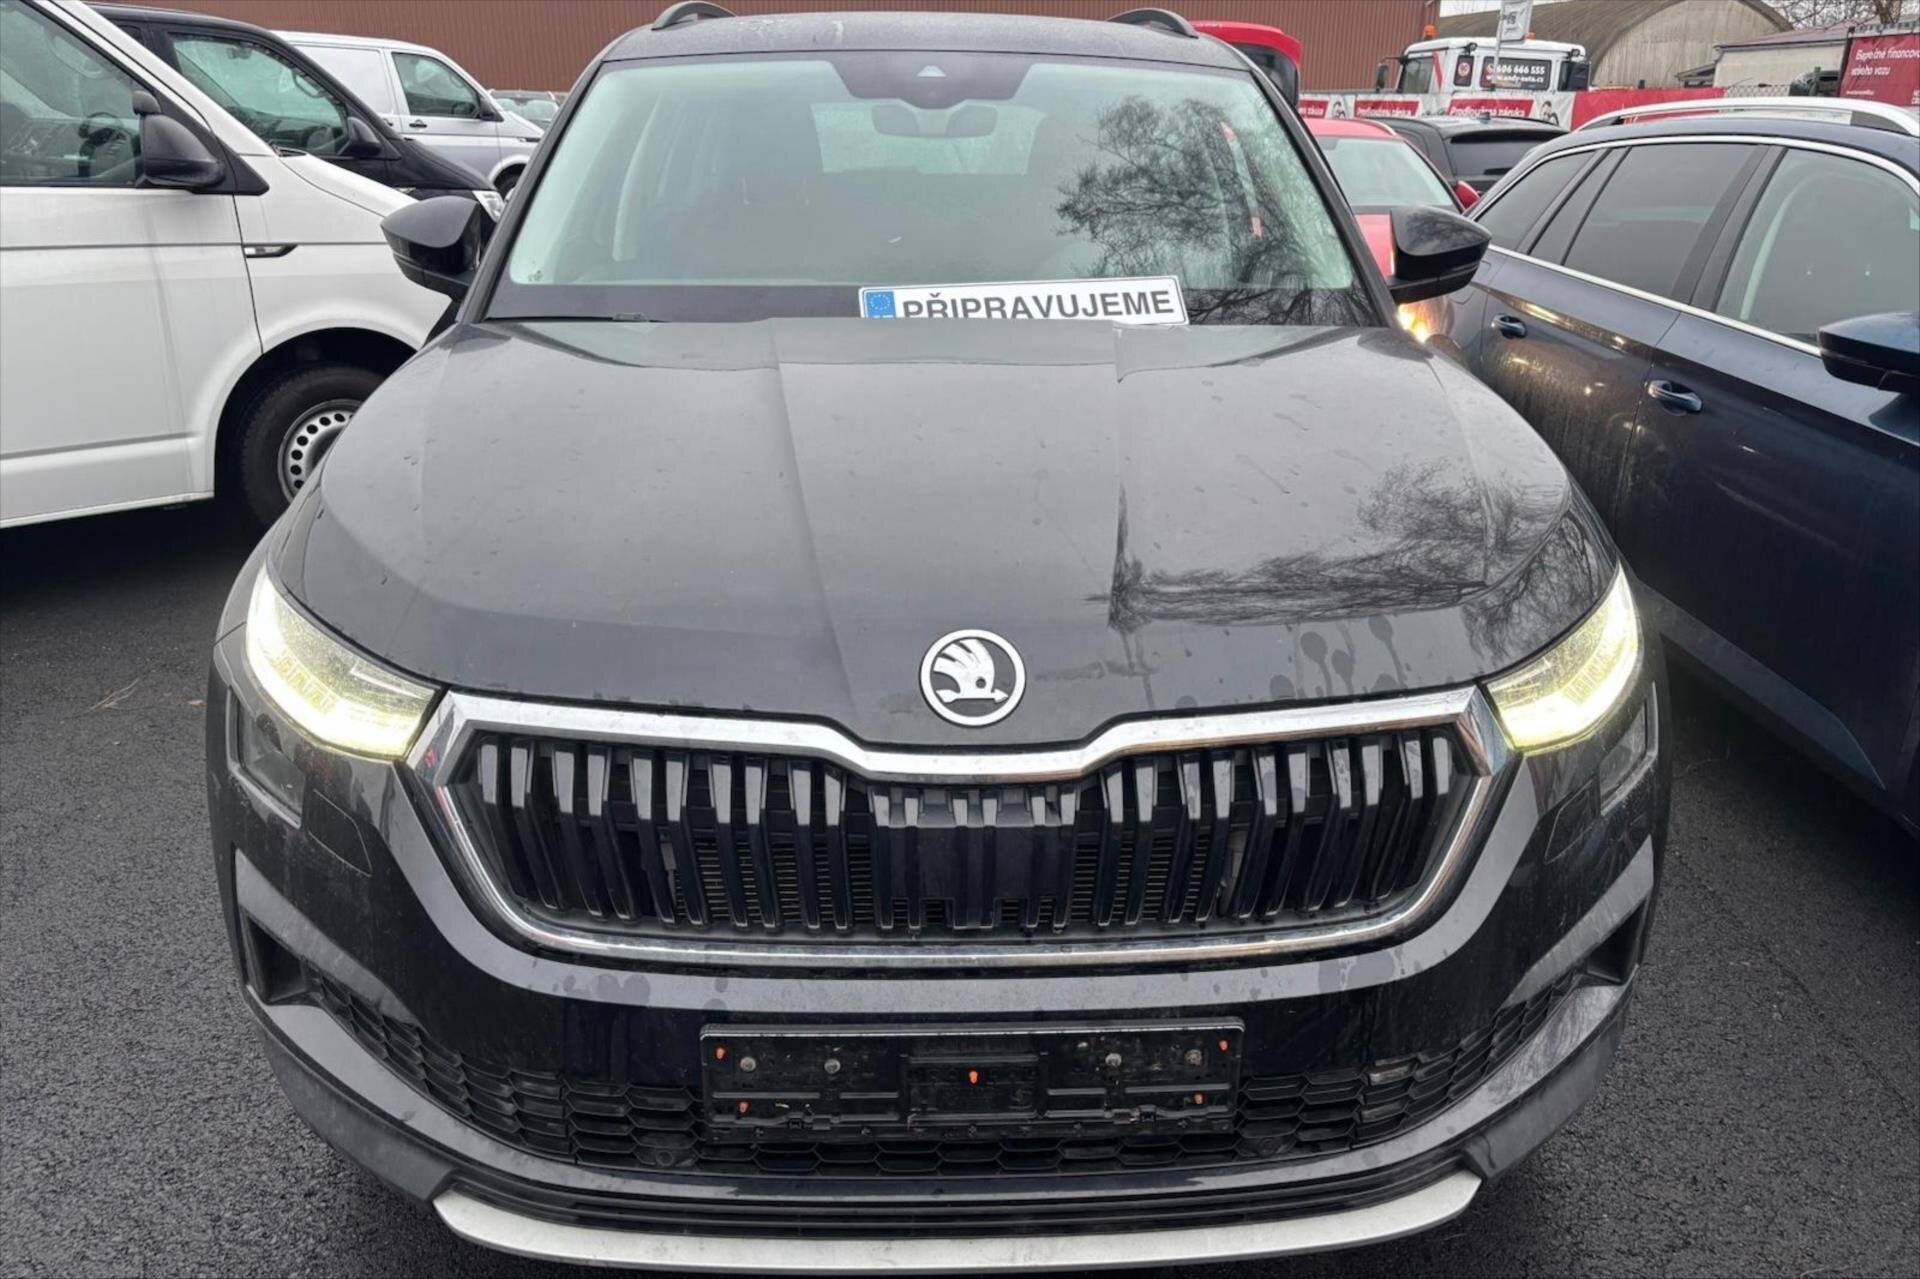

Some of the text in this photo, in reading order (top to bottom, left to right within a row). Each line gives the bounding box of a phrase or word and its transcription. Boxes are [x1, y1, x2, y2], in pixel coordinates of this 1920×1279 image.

[1496, 64, 1545, 75] 606 666 555
[902, 290, 1174, 319] PŘIPRAVUJEME
